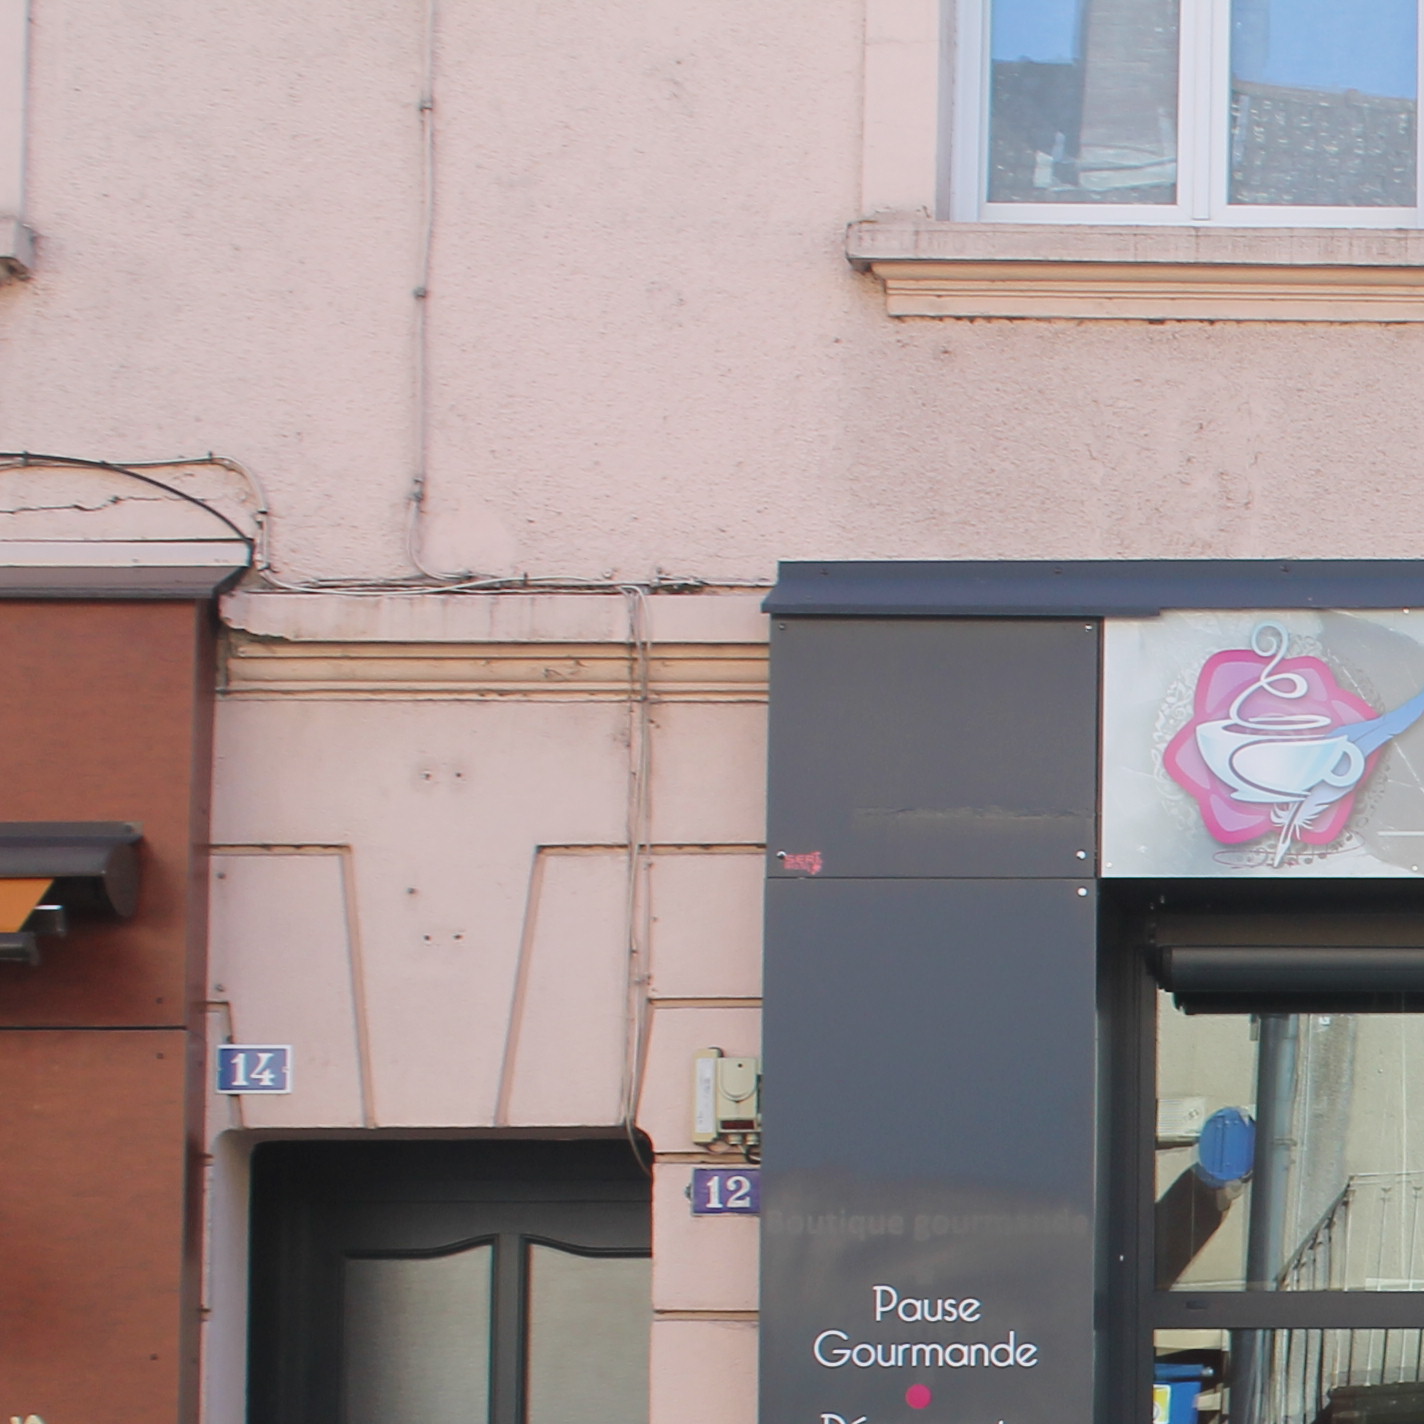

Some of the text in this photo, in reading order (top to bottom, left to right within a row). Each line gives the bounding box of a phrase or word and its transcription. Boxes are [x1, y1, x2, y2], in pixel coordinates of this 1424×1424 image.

[230, 1052, 276, 1087] 14
[705, 1175, 752, 1209] 12
[872, 1285, 981, 1322] Pause
[813, 1330, 1038, 1368] Gourmande
